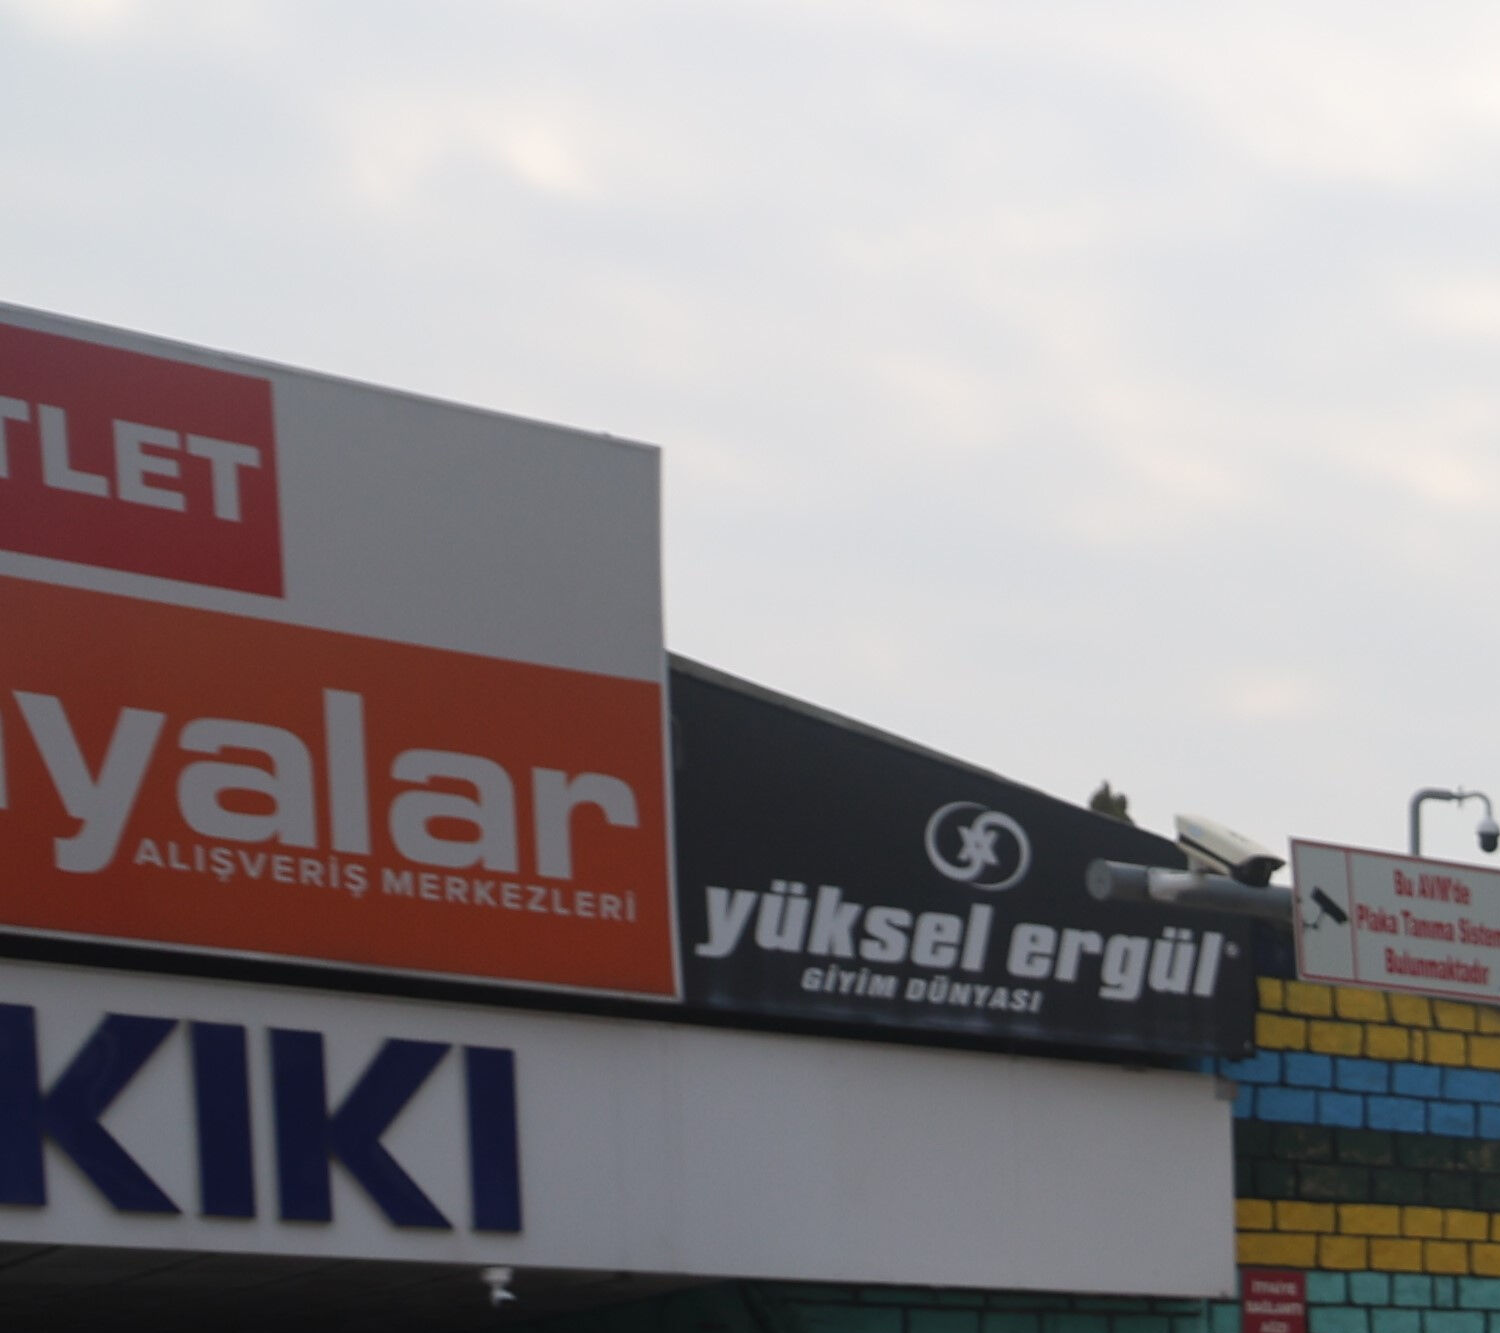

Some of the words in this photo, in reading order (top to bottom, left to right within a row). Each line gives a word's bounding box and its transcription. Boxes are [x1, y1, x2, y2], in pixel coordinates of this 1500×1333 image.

[0, 687, 639, 880] yalar
[135, 839, 368, 898] ALIŞVERİŞ
[382, 869, 636, 922] MERKEZLERİ
[1357, 903, 1398, 934] Plaka
[696, 881, 992, 970] yüksel
[1007, 922, 1222, 1000] ergül
[906, 976, 1043, 1014] DÜNYASI
[0, 1004, 521, 1233] KIKI
